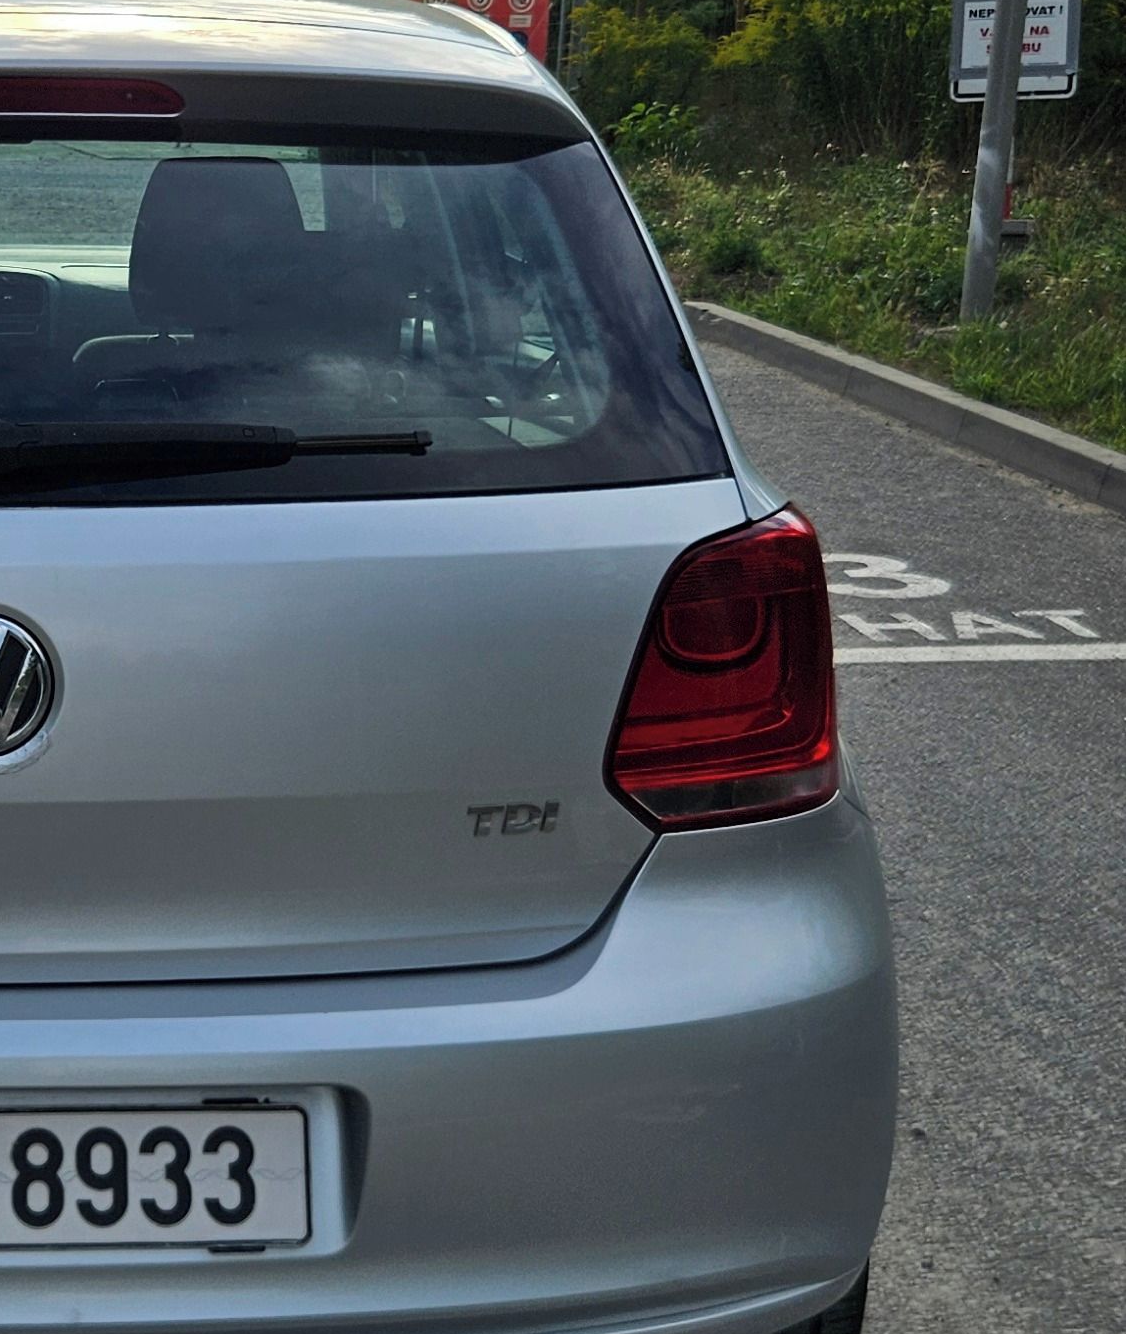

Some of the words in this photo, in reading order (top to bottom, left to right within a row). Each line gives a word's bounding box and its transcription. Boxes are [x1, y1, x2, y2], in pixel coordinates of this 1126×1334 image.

[1029, 25, 1051, 36] NA
[466, 801, 560, 837] TDI
[10, 1125, 256, 1229] 8933
